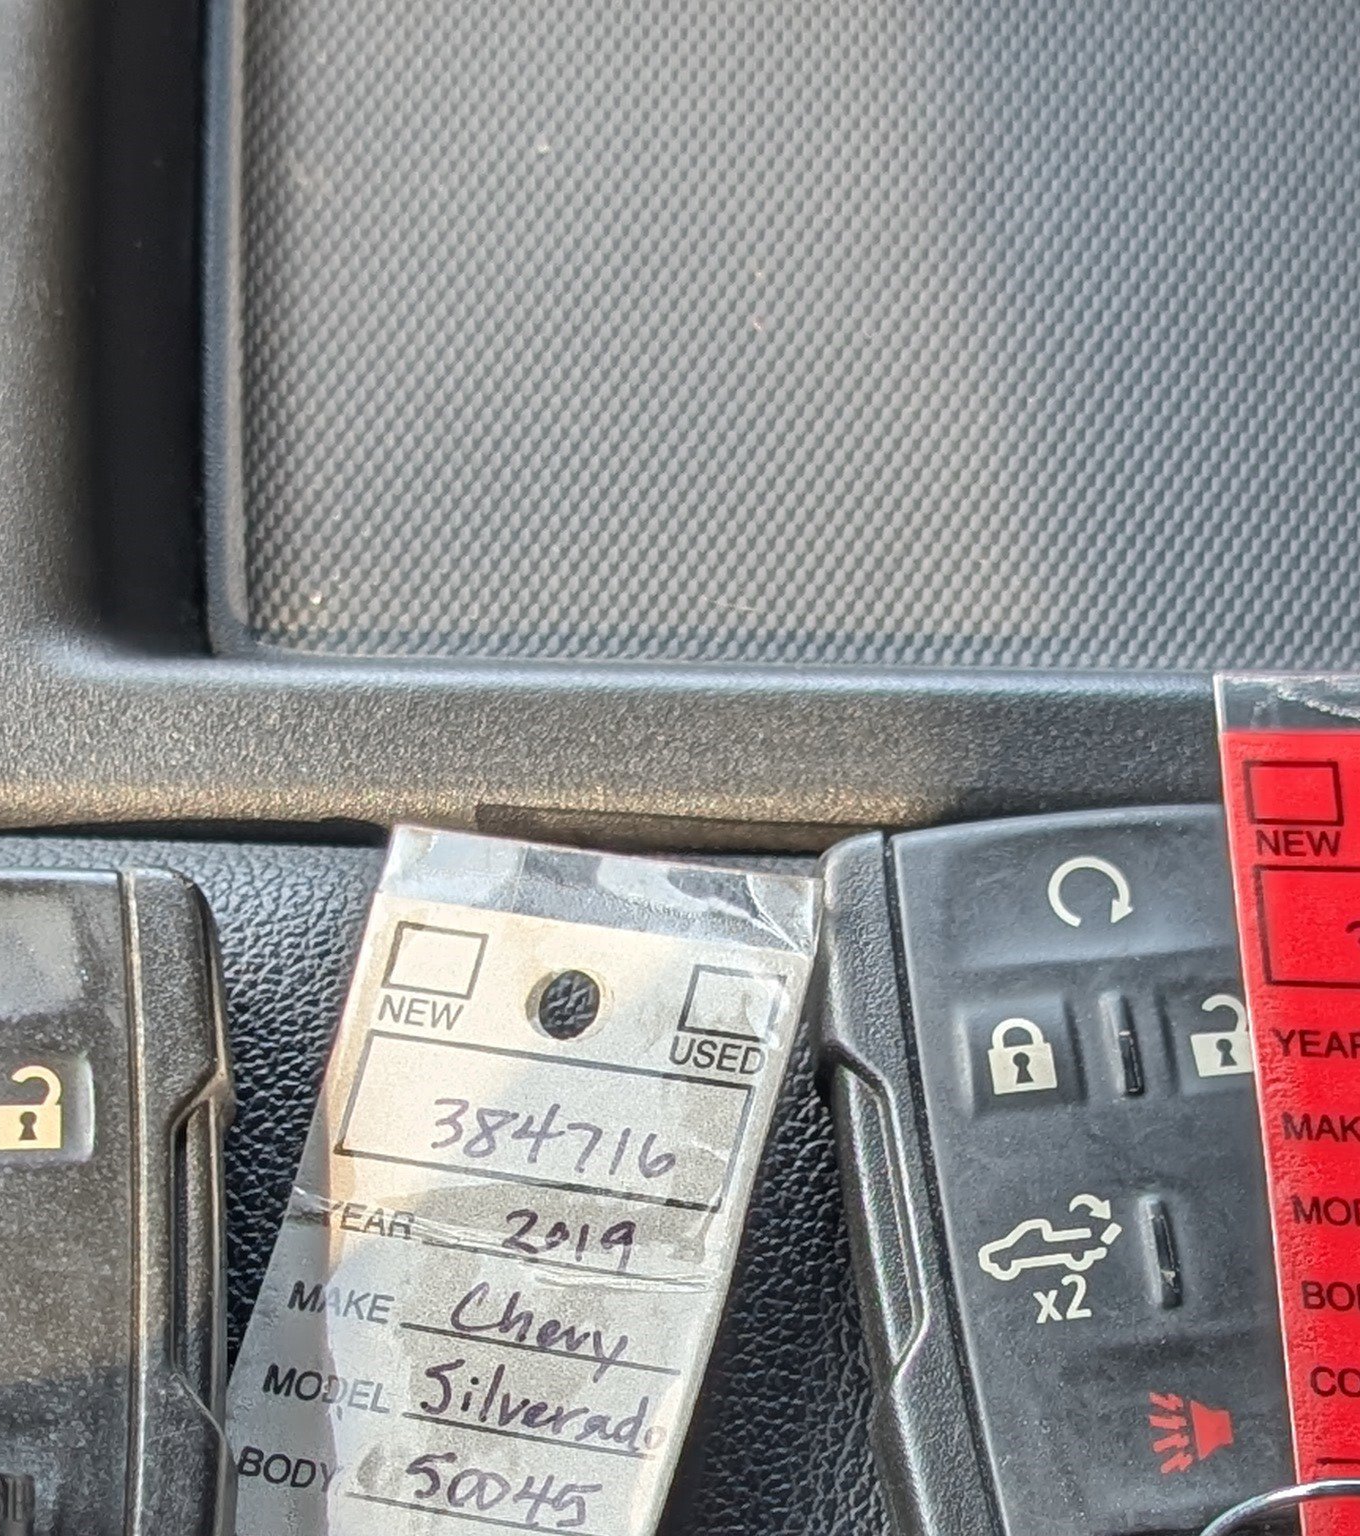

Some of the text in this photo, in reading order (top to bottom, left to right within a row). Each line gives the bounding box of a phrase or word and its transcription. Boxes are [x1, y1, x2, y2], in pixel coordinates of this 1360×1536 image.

[1256, 829, 1341, 857] NEW
[378, 993, 767, 1075] NEW USED
[430, 1098, 677, 1179] 384716
[503, 1209, 638, 1263] 2019
[287, 1279, 396, 1325] MAKE
[1033, 1276, 1093, 1325] x2
[262, 1364, 391, 1415] MODEL
[419, 1357, 667, 1454] Silverado
[238, 1445, 342, 1494] BODY
[404, 1450, 602, 1529] 50045
